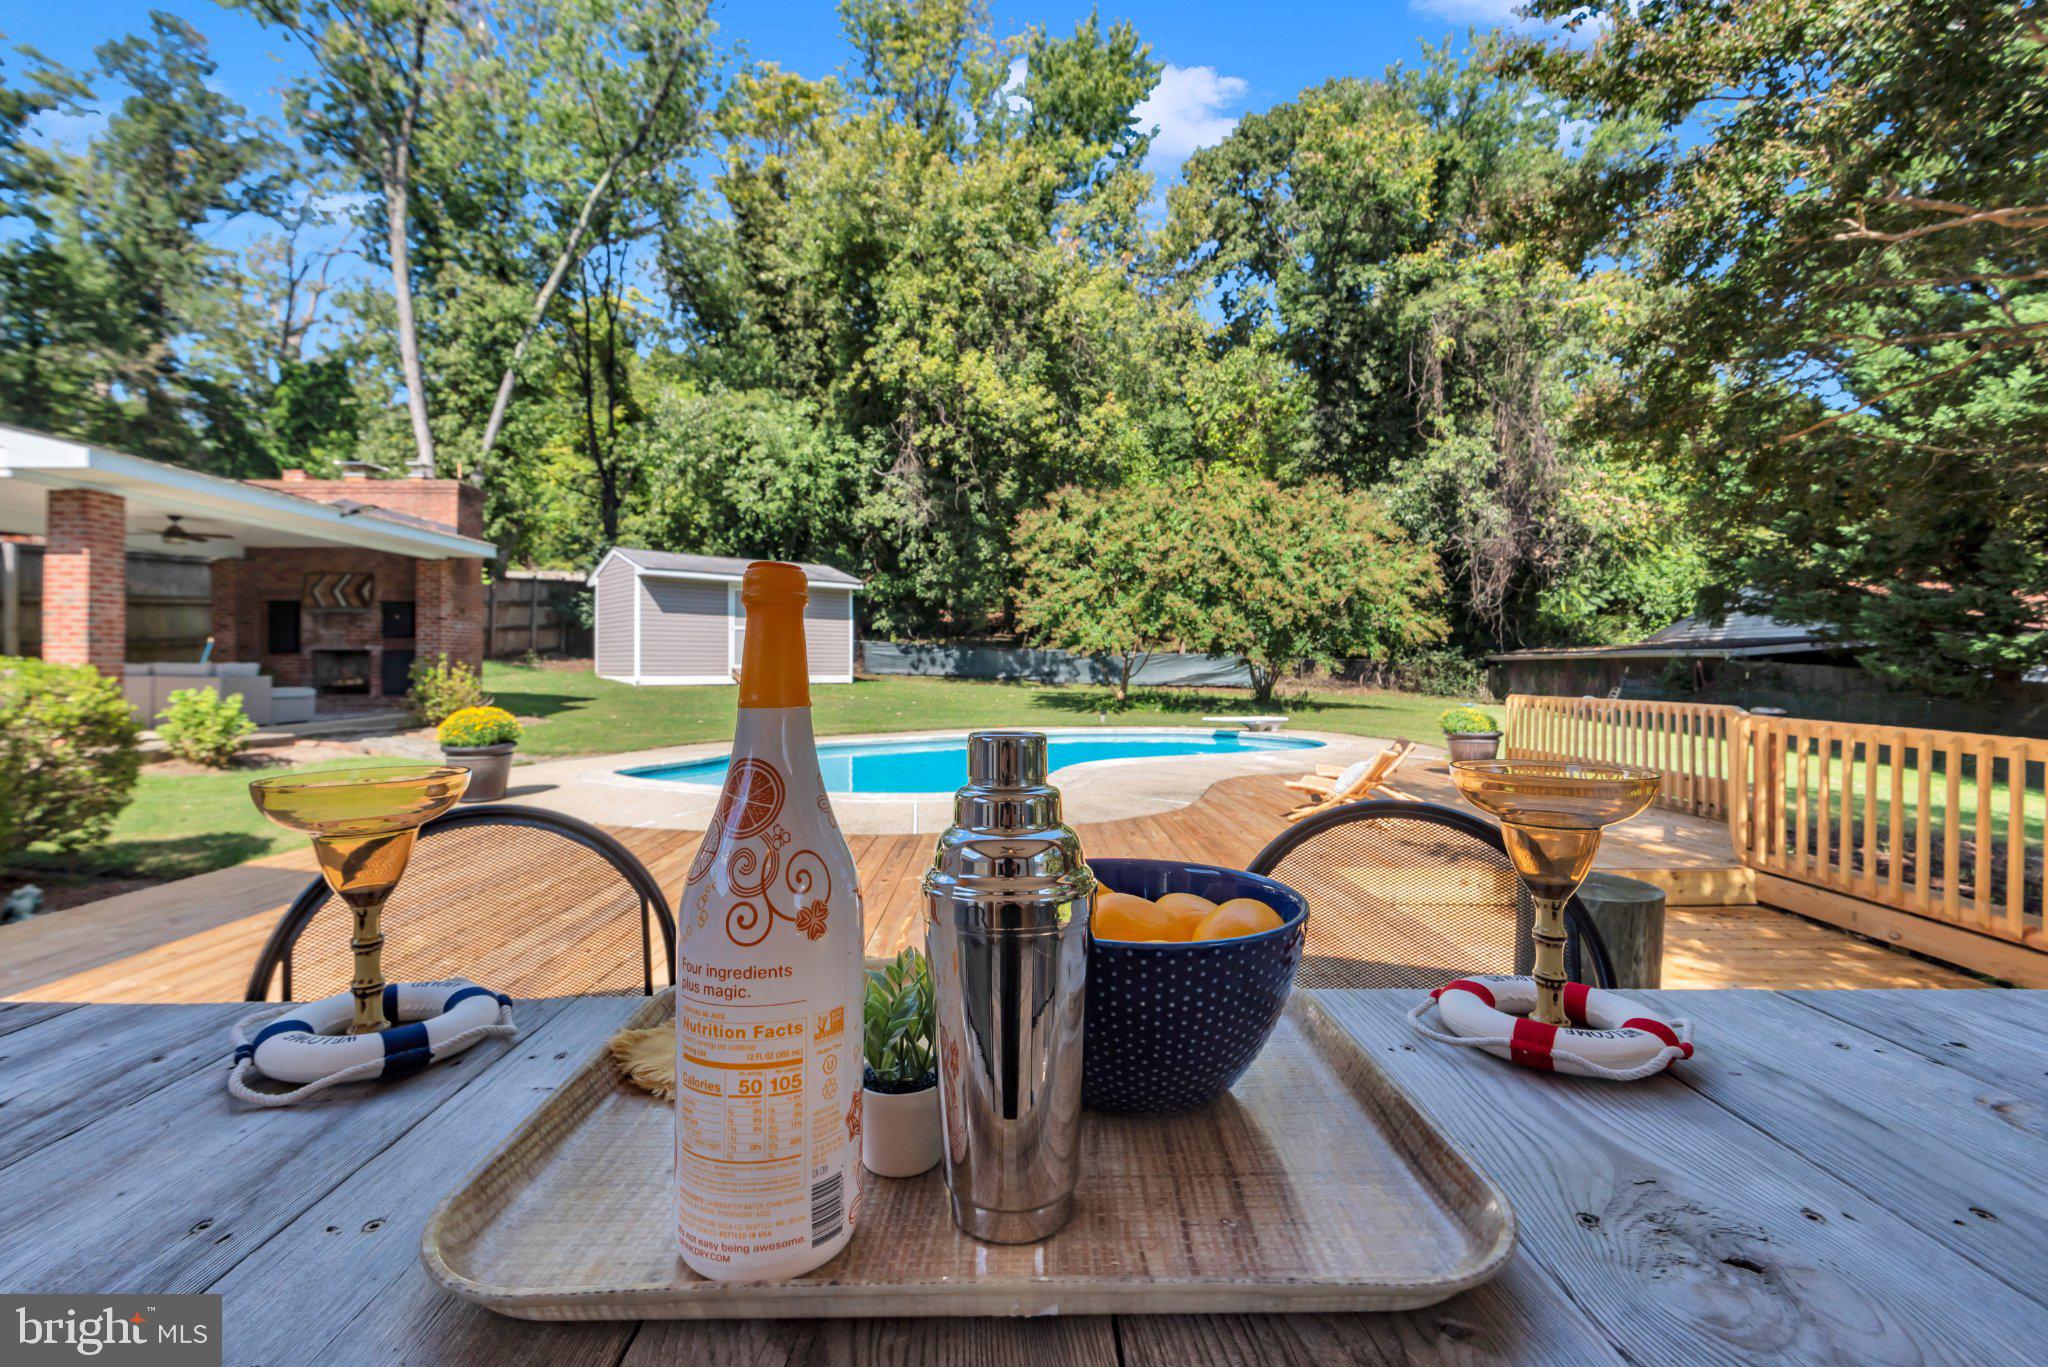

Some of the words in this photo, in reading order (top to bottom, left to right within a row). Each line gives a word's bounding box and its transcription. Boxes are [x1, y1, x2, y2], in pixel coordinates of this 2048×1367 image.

[681, 956, 702, 975] Four
[706, 963, 793, 982] ingredients
[681, 977, 700, 993] plus
[703, 984, 751, 1001] magic.
[683, 1016, 746, 1039] Nutrition
[753, 1023, 804, 1039] Facts
[682, 1071, 721, 1093] Calories
[738, 1079, 763, 1095] 50
[769, 1073, 802, 1092] 105
[699, 1239, 719, 1251] easy
[721, 1243, 750, 1255] being
[753, 1236, 806, 1252] awesome.
